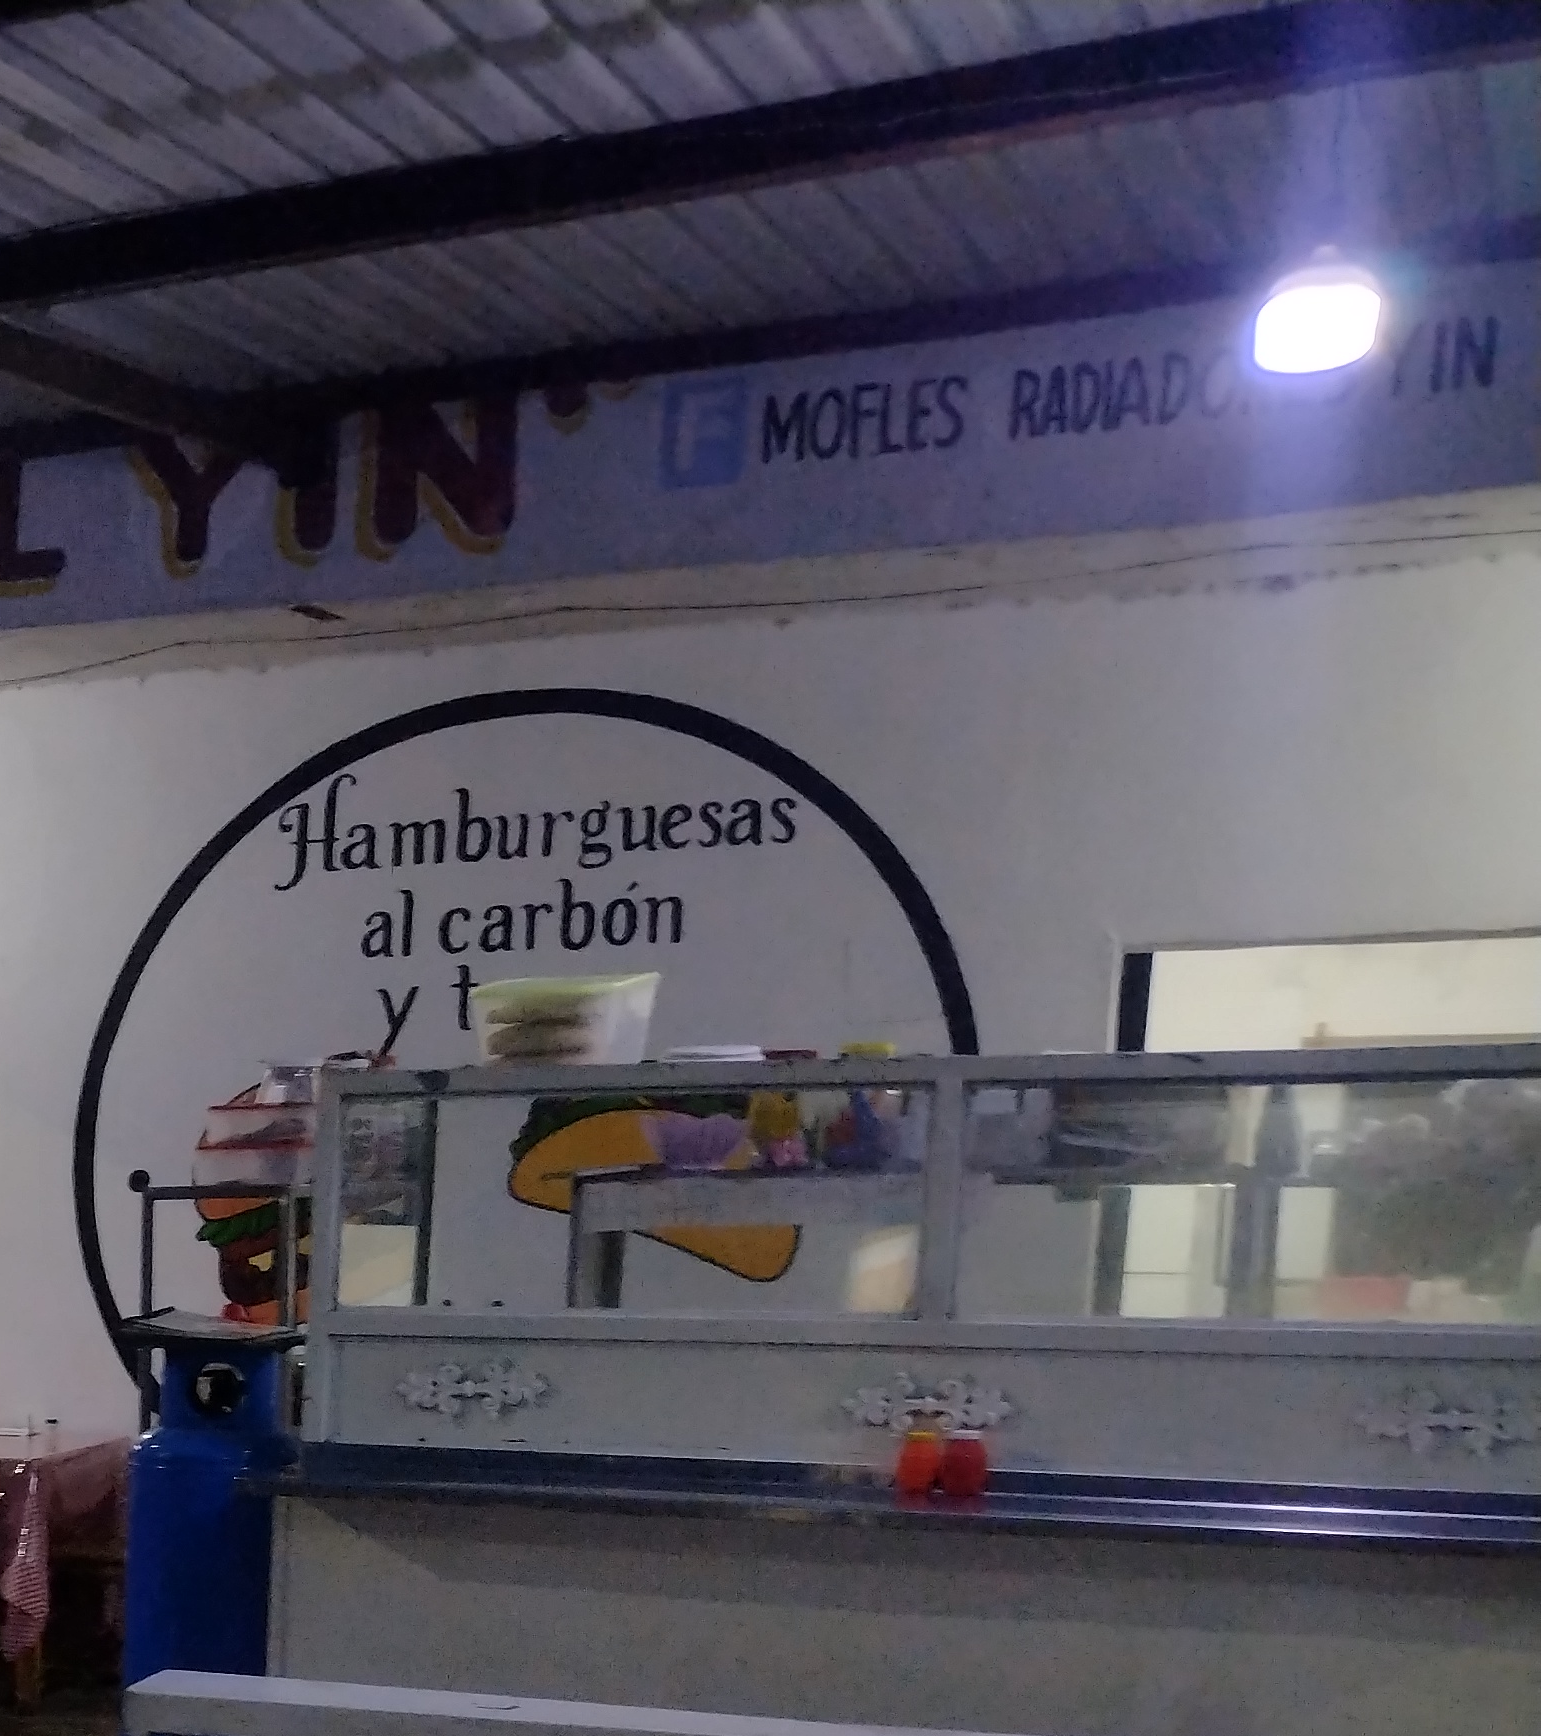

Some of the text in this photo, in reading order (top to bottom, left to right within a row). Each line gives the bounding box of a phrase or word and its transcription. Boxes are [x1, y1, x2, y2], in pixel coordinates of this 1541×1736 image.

[762, 375, 967, 464] MOFLES
[274, 773, 797, 891] Hamburguesas
[361, 878, 683, 958] al carbón
[377, 985, 419, 1056] y
